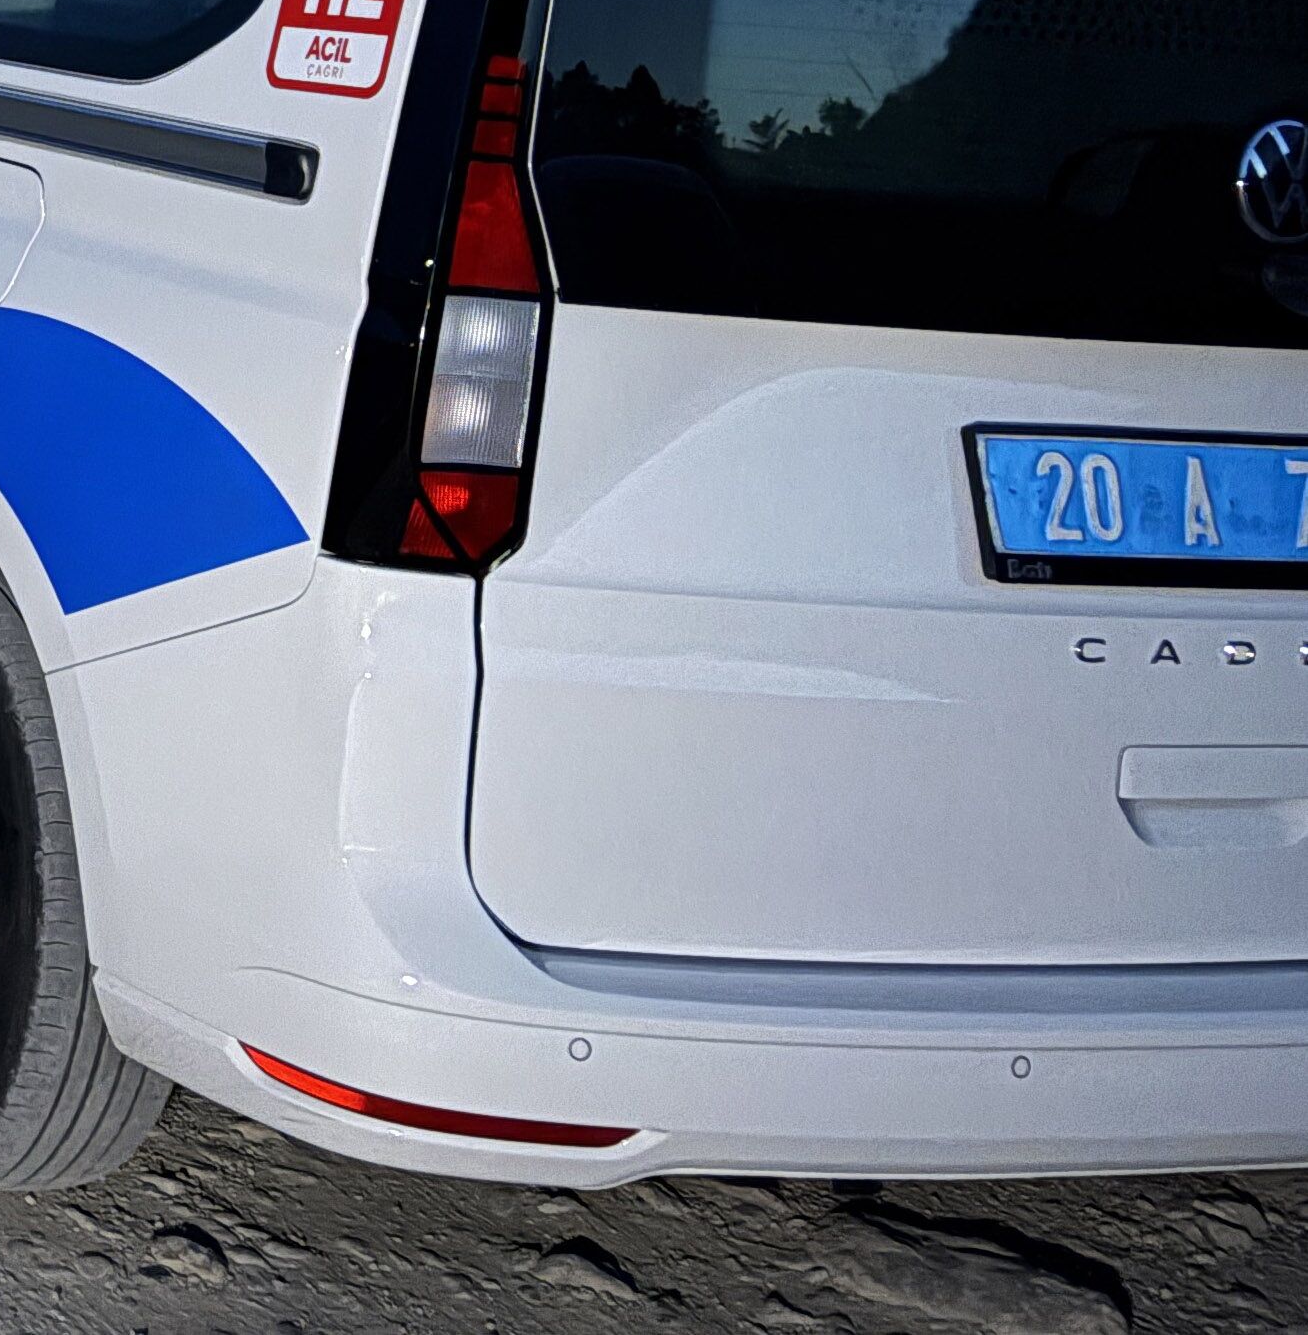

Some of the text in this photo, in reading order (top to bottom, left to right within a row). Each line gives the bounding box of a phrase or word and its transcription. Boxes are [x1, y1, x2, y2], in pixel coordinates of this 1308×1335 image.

[305, 35, 352, 63] ACİL
[1036, 451, 1124, 542] 20
[1184, 455, 1222, 547] A
[1072, 637, 1308, 666] CAD
